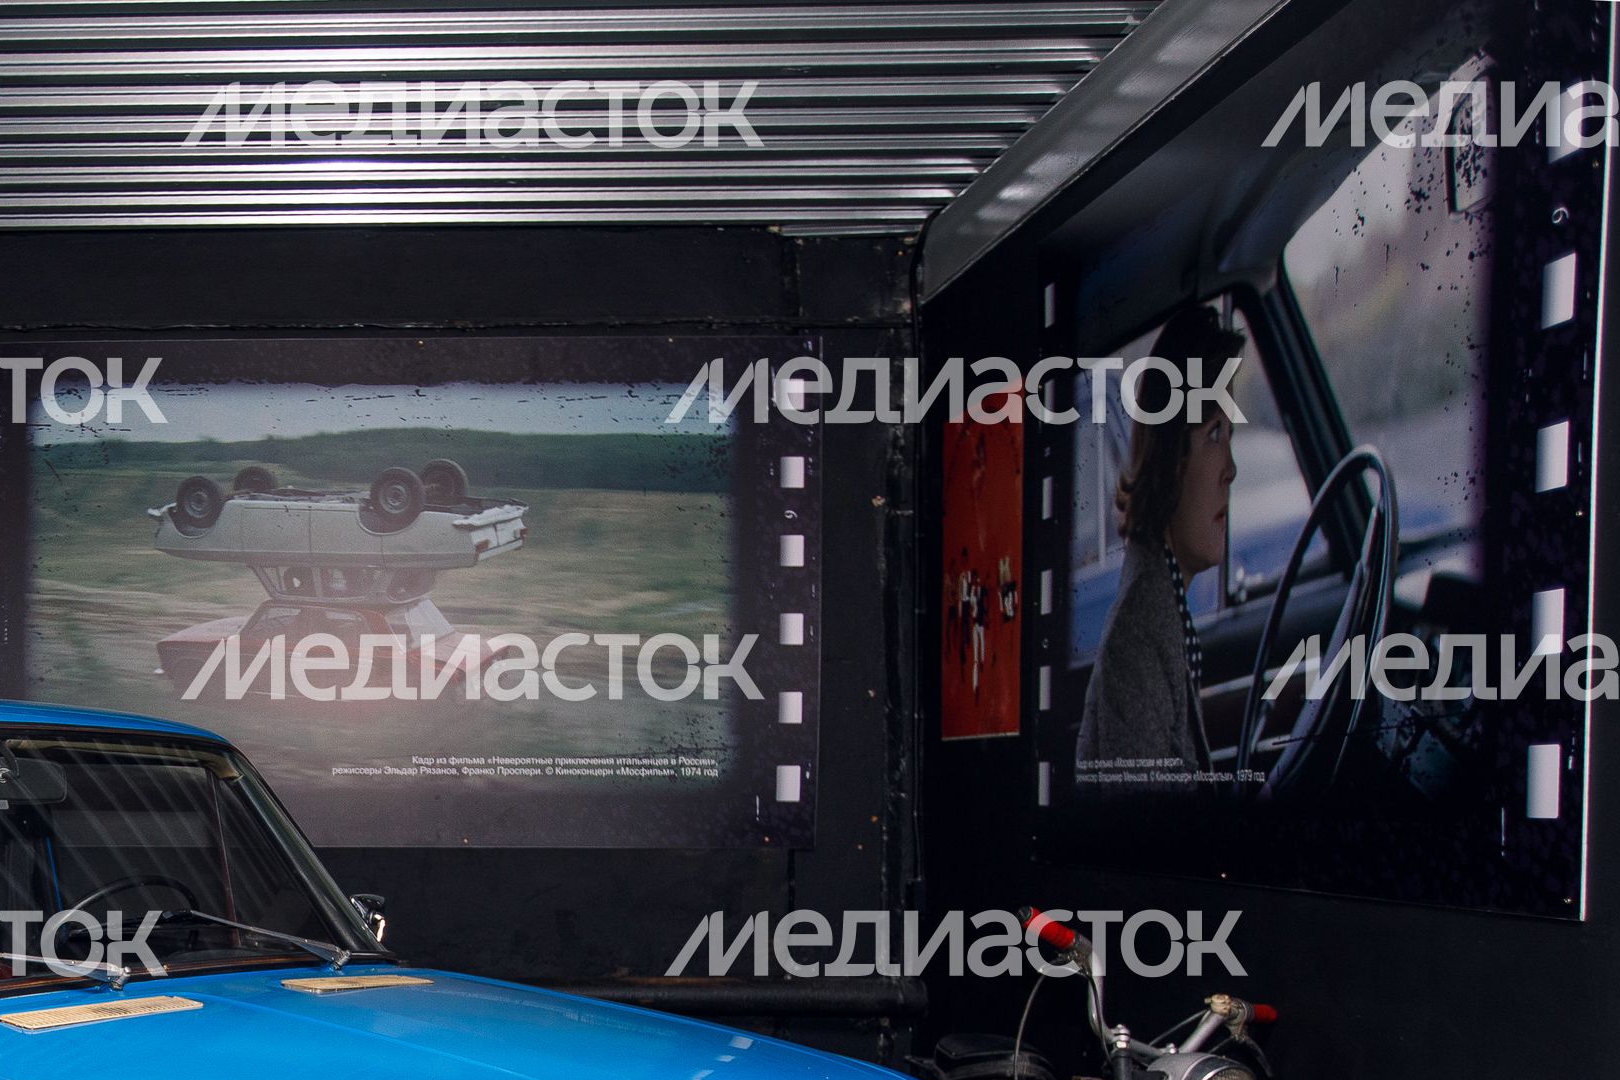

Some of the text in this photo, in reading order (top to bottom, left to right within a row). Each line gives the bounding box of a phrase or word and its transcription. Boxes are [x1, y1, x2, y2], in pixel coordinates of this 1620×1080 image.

[412, 756, 433, 766] Кадр
[436, 756, 447, 766] из
[450, 756, 485, 766] фильма
[488, 756, 553, 766] «Невероятные
[555, 756, 614, 766] приключения
[616, 756, 669, 766] итальянцев
[384, 766, 418, 776] Эльдар
[462, 766, 495, 776] Франко
[555, 766, 613, 776] Киноконцерн
[681, 766, 701, 776] 1974
[704, 766, 719, 776] год
